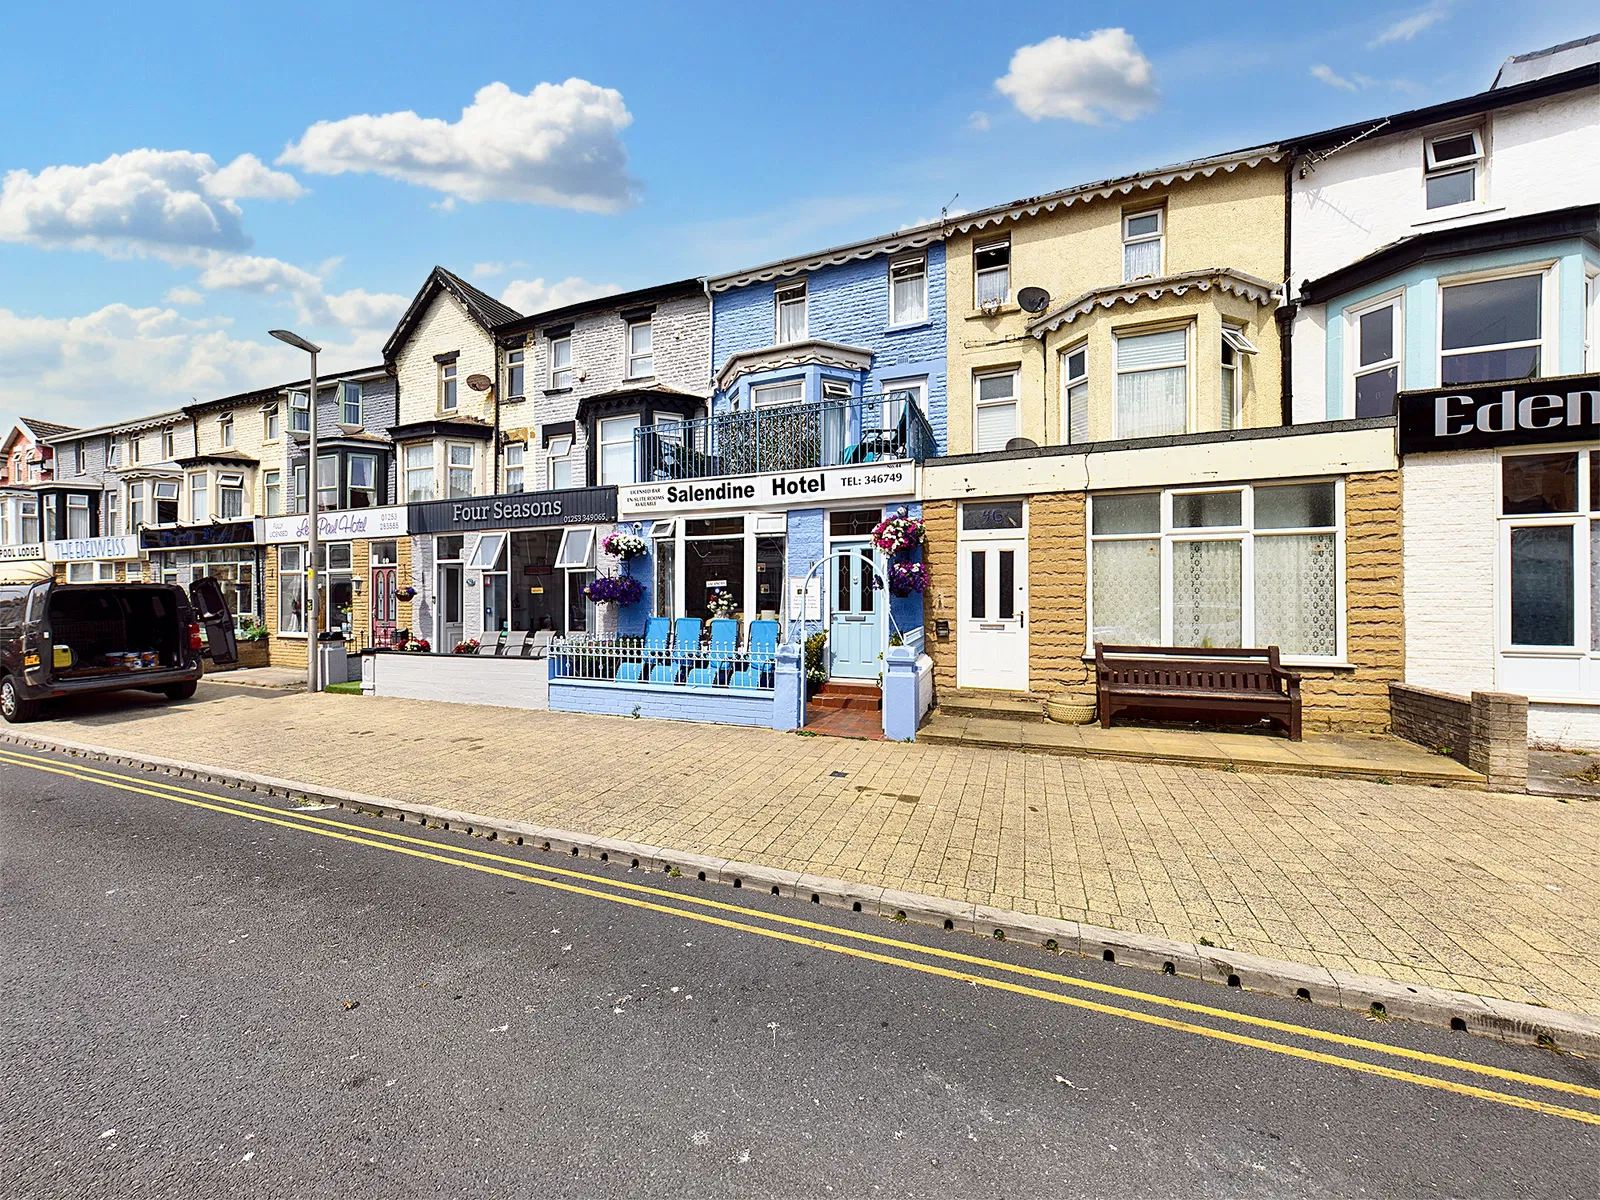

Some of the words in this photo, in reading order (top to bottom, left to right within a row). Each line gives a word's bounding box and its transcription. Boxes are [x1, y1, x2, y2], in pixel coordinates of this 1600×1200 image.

[1434, 390, 1600, 436] Eden
[667, 484, 755, 503] Salendine
[772, 473, 826, 496] Hotel
[840, 477, 861, 487] TEL:
[864, 472, 903, 485] 346749
[380, 512, 398, 521] 01253
[452, 503, 490, 522] Four
[493, 499, 562, 520] Seasons
[563, 514, 581, 523] 01253
[339, 514, 367, 534] Hotel
[18, 546, 40, 557] LODGE
[54, 541, 74, 559] THE
[75, 538, 126, 559] EDELWEISS
